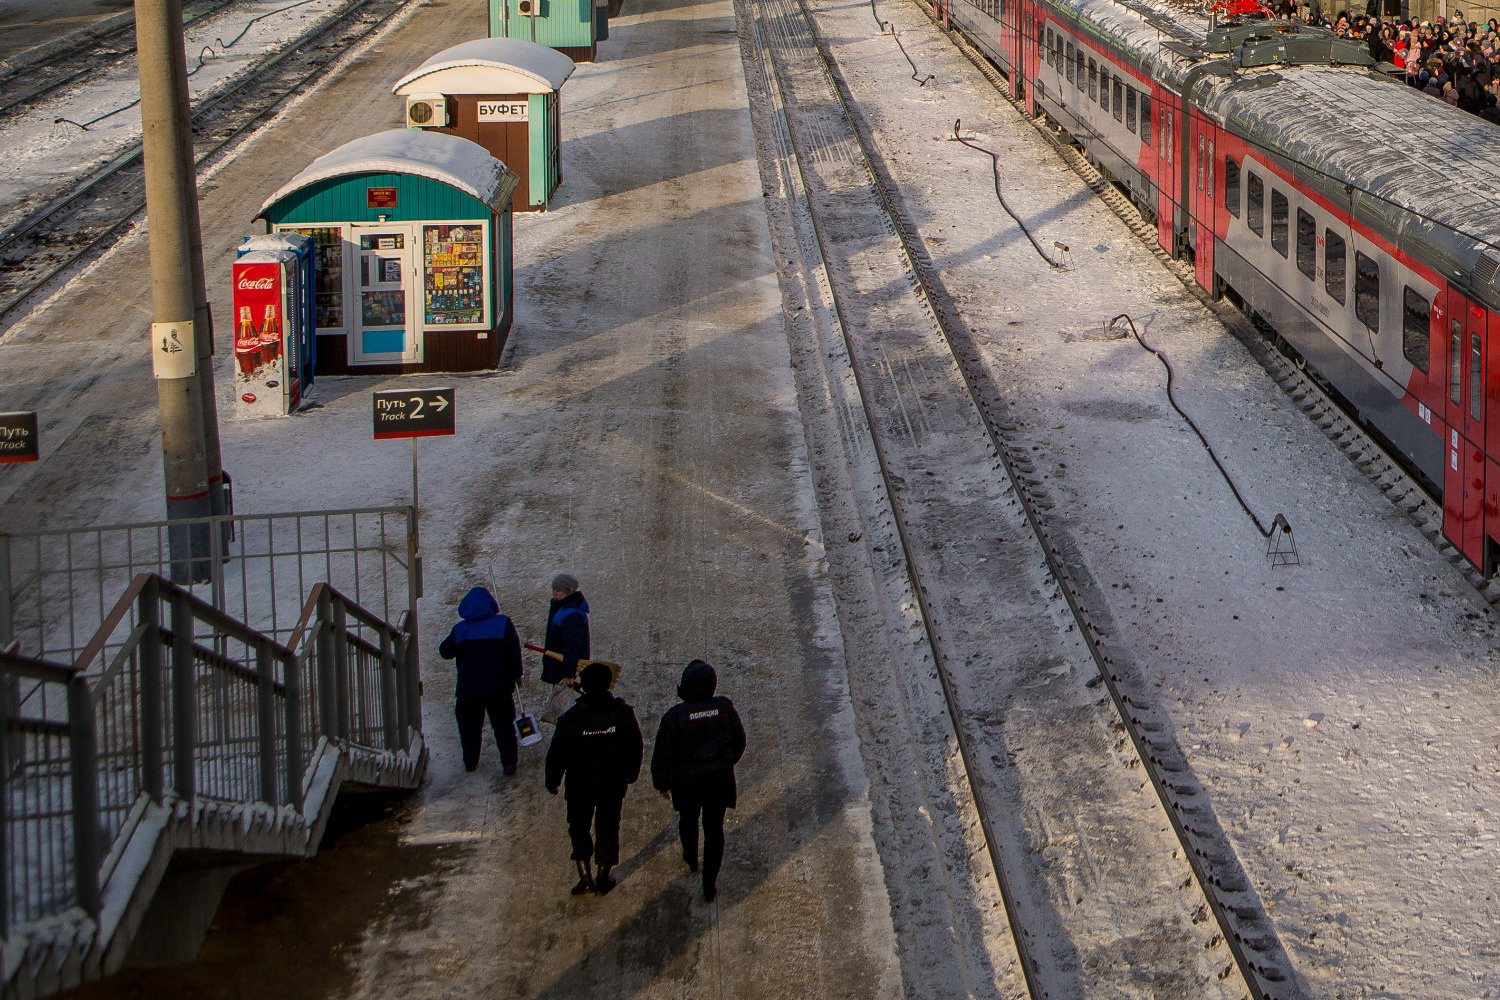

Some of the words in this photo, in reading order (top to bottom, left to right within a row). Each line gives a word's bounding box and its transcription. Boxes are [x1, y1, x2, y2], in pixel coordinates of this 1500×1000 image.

[479, 104, 527, 115] БУФЕТ
[238, 278, 275, 290] Coca-Cola
[377, 399, 406, 411] Путь
[409, 397, 425, 419] 2
[381, 412, 406, 420] Track
[0, 426, 29, 440] Путь
[0, 440, 26, 449] Track
